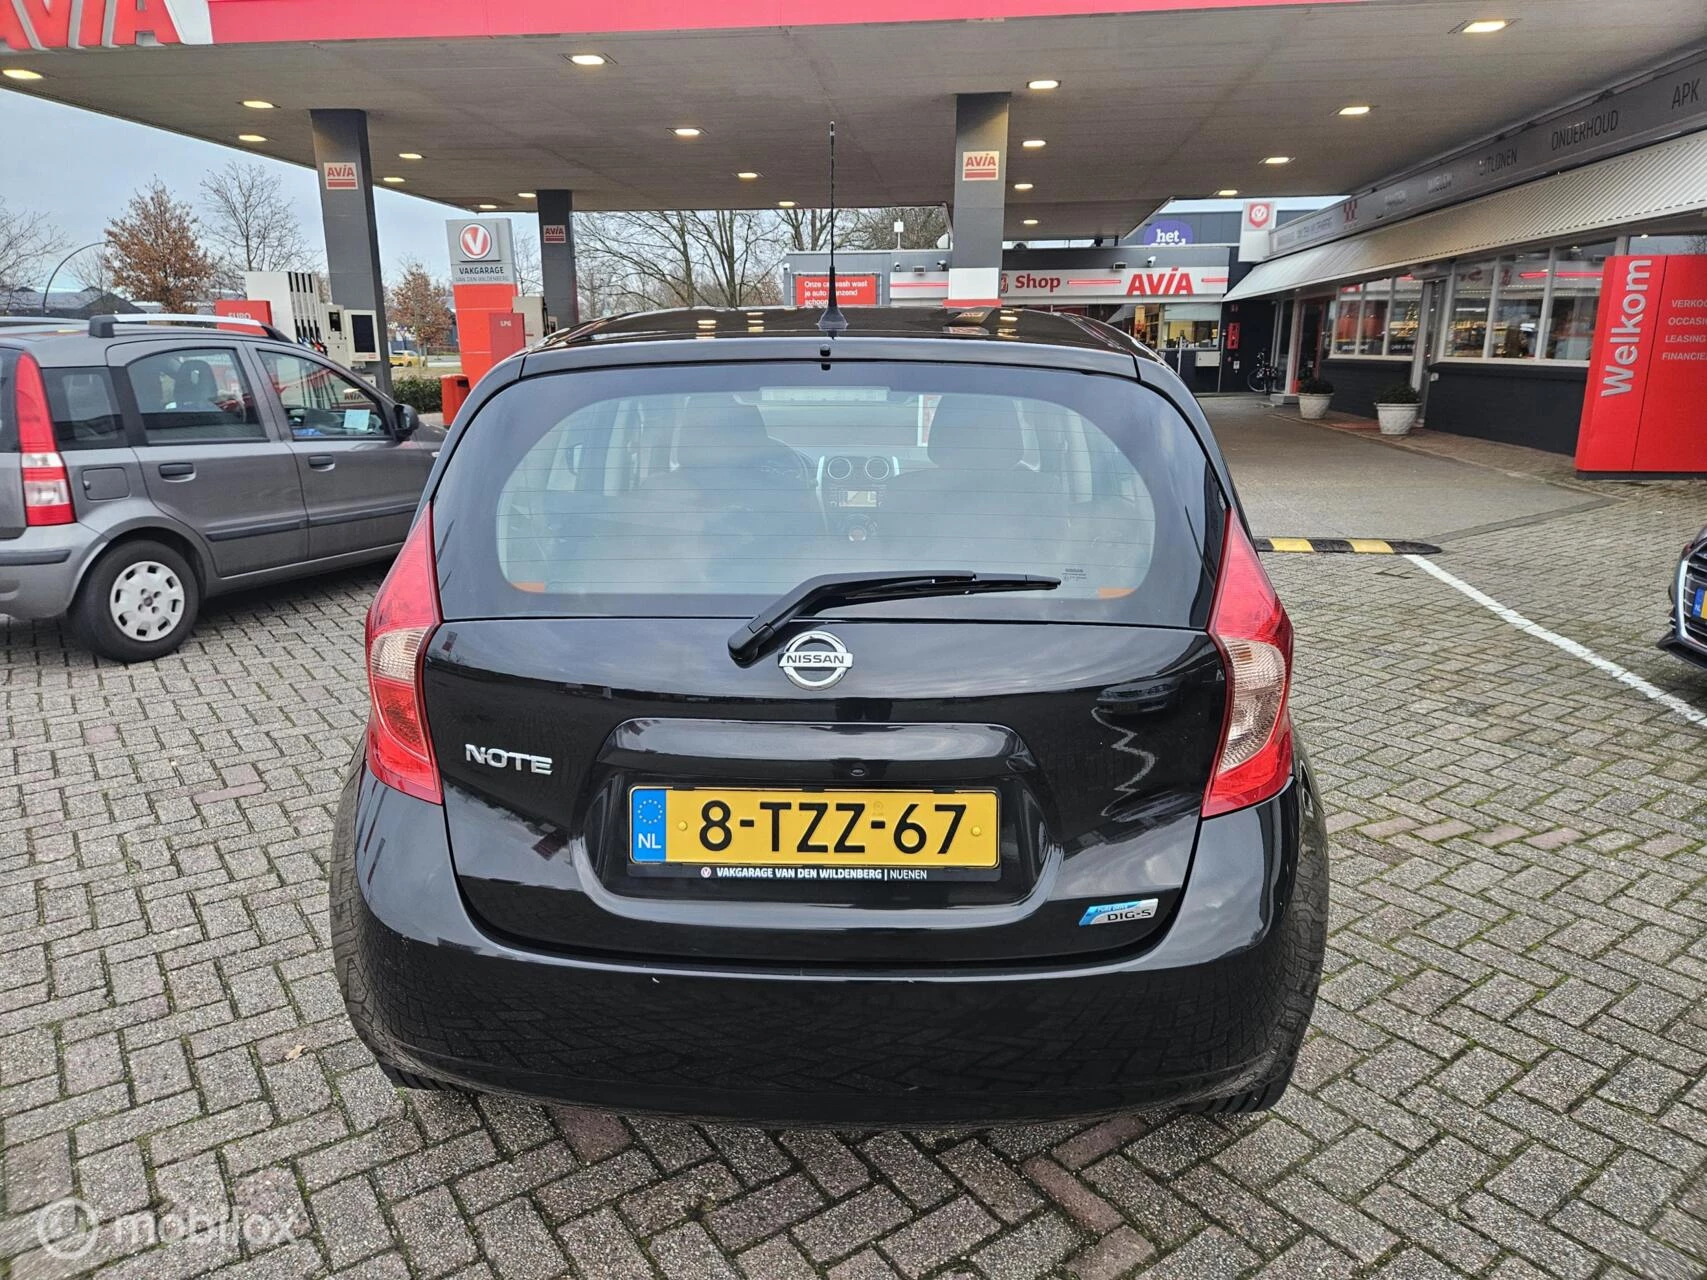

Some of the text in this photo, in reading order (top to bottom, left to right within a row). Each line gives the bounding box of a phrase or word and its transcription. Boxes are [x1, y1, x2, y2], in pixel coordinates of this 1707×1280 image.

[1672, 78, 1700, 109] APK
[1552, 110, 1619, 150] ONDERHOUD
[966, 153, 996, 167] AVIA
[327, 165, 355, 177] AVIA
[1156, 228, 1179, 242] het
[459, 266, 504, 275] VAKGARAGE
[1015, 273, 1061, 293] Shop
[1126, 267, 1194, 296] AVIA
[804, 289, 811, 298] je
[1601, 259, 1652, 397] Welkom
[1665, 335, 1706, 343] LEASING
[786, 655, 844, 664] NISSAN
[465, 743, 552, 775] NOTE
[638, 800, 967, 855] NL 8-TZZ-67
[716, 867, 773, 878] VAKGARAGE
[775, 868, 796, 878] VAN
[797, 869, 818, 879] DEN
[819, 869, 882, 880] WILDENBERG
[889, 870, 928, 881] NUENEN
[1107, 909, 1152, 921] DIG-S
